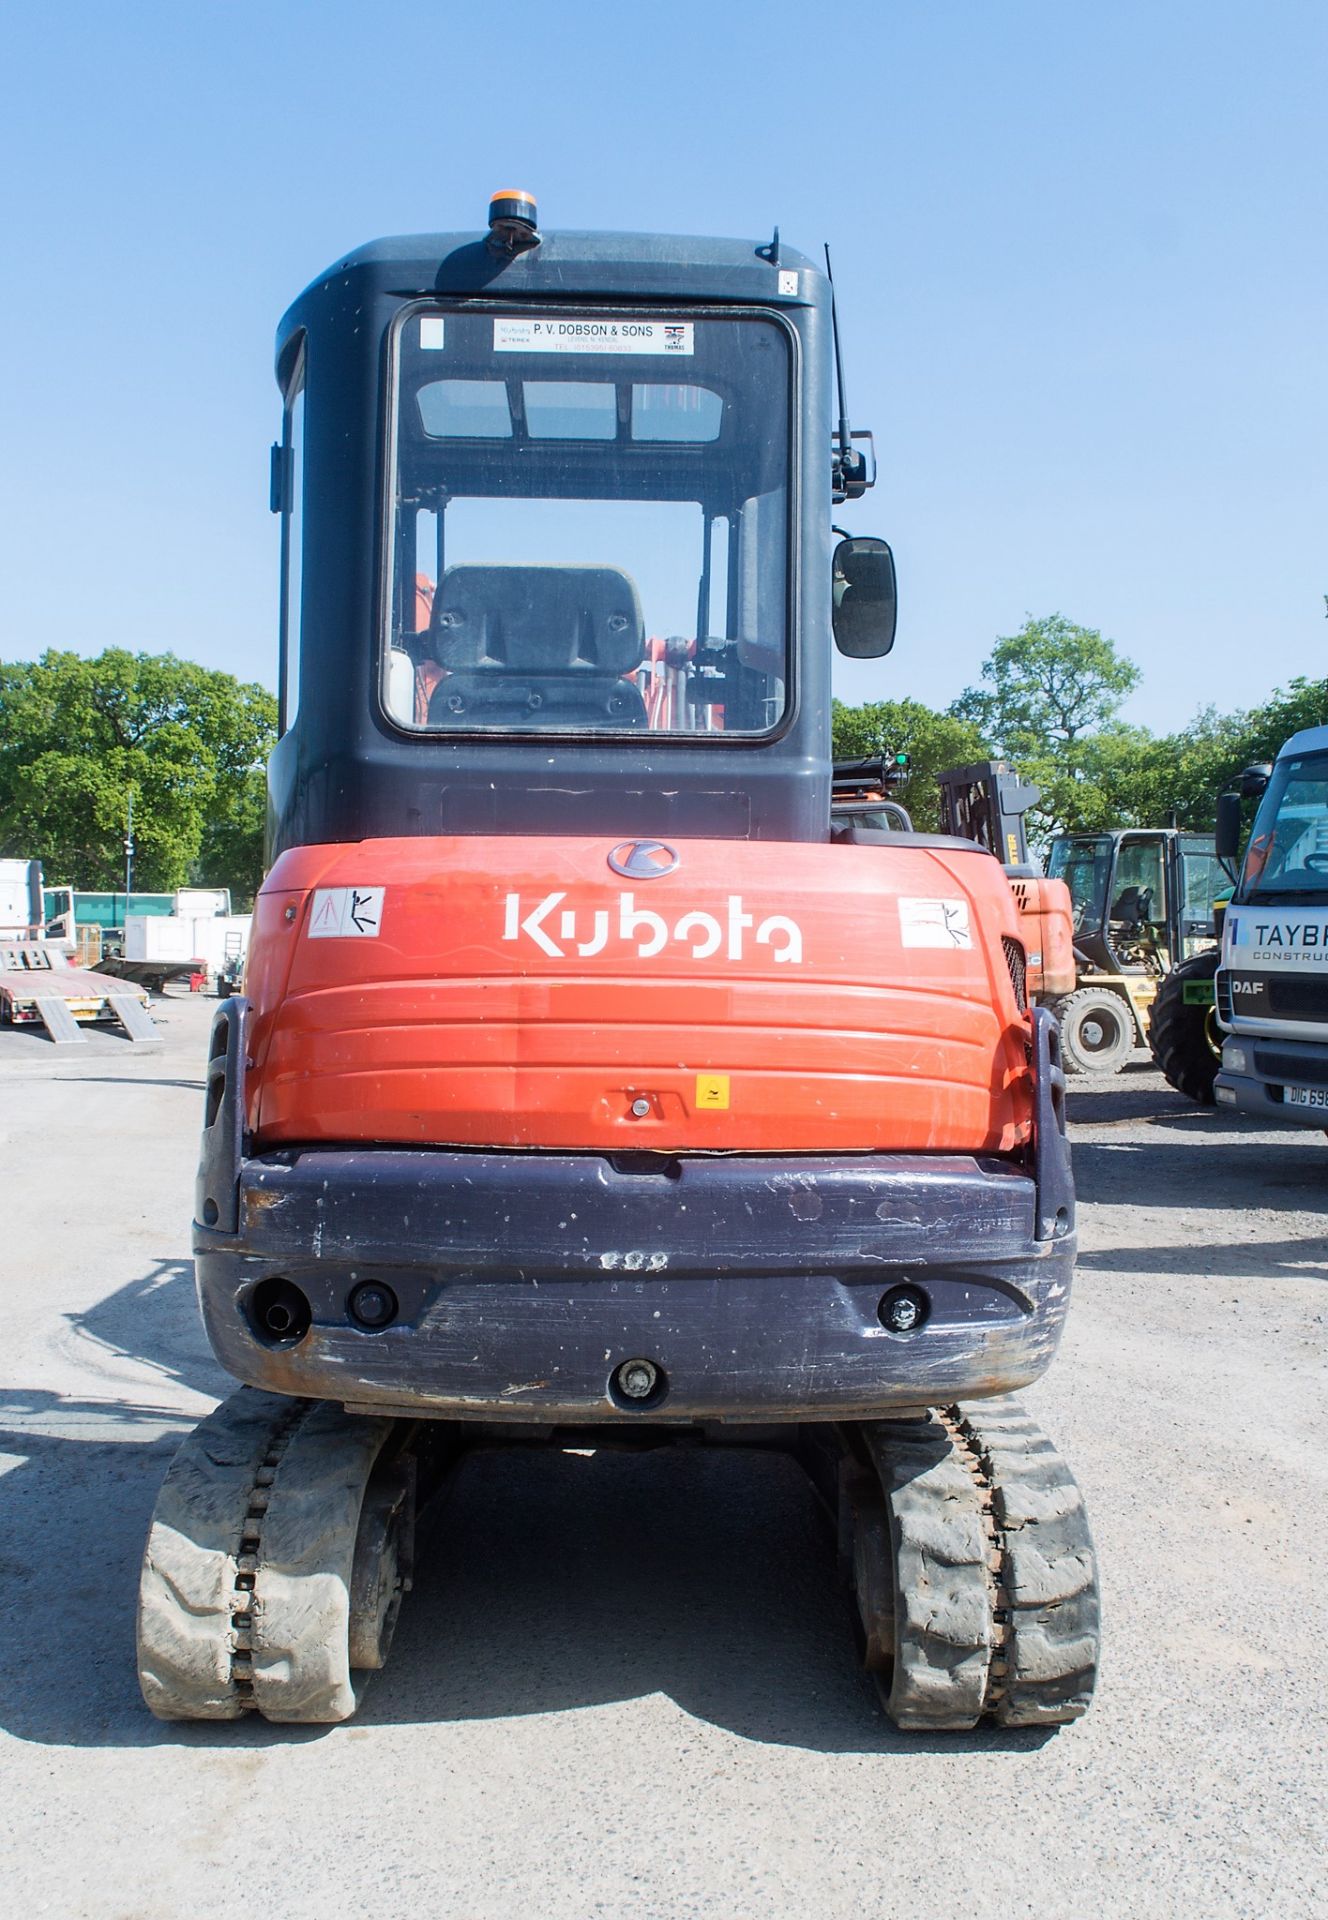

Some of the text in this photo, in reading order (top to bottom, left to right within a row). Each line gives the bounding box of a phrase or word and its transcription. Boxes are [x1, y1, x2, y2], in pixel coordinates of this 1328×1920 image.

[533, 323, 543, 335] P.
[545, 323, 556, 335] V.
[558, 324, 607, 336] DOBSON
[610, 325, 618, 336] &
[621, 325, 654, 337] SONS
[502, 891, 803, 964] Kubota
[1232, 981, 1264, 995] DAF
[1290, 1086, 1307, 1104] DIG
